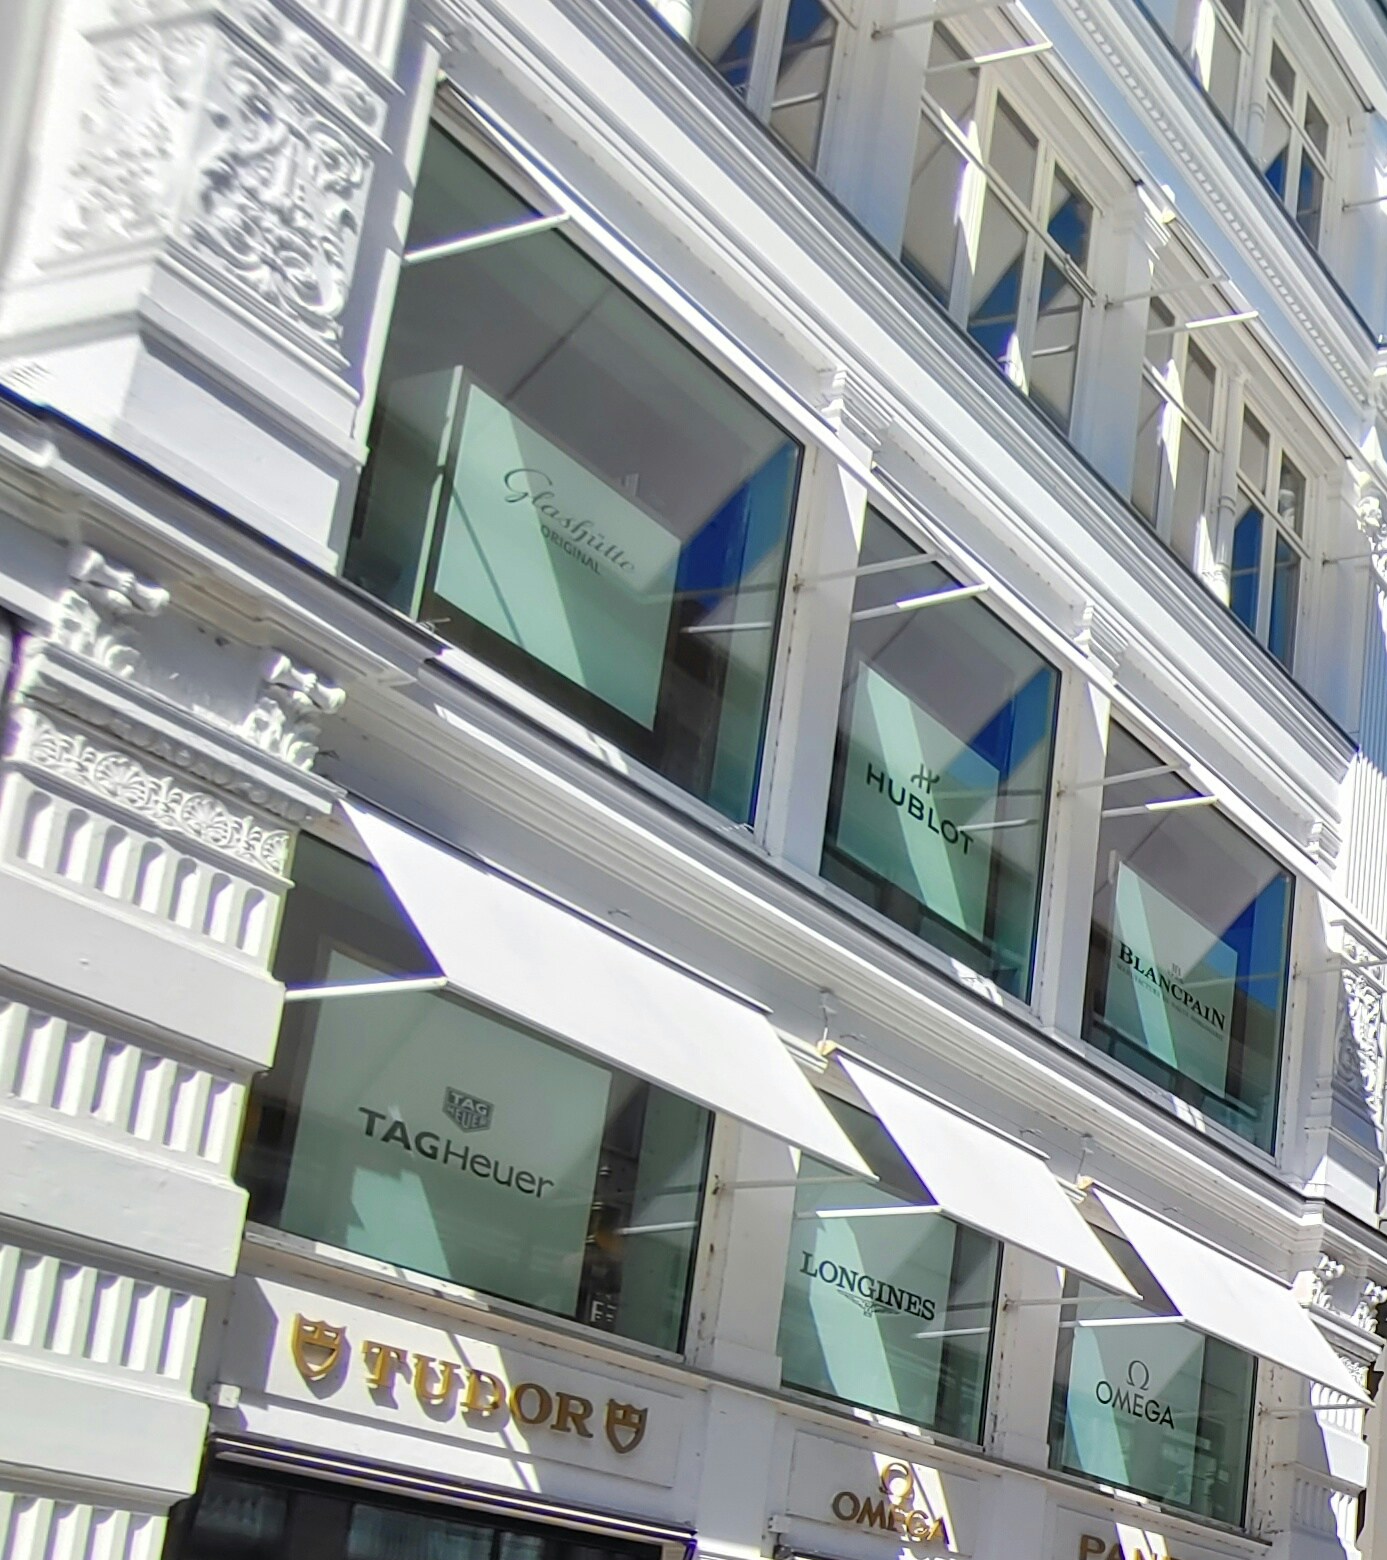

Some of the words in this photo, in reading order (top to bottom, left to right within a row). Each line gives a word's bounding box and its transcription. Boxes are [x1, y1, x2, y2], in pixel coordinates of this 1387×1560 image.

[541, 524, 602, 575] ORIGINAL
[866, 762, 974, 855] HUBLOT
[1118, 941, 1225, 1031] BLANCPAIN
[450, 1092, 488, 1116] TAG
[799, 1250, 936, 1321] LONGINES
[362, 1339, 594, 1439] TUDOR
[1096, 1380, 1175, 1430] OMEGA
[832, 1491, 951, 1546] OMEGA
